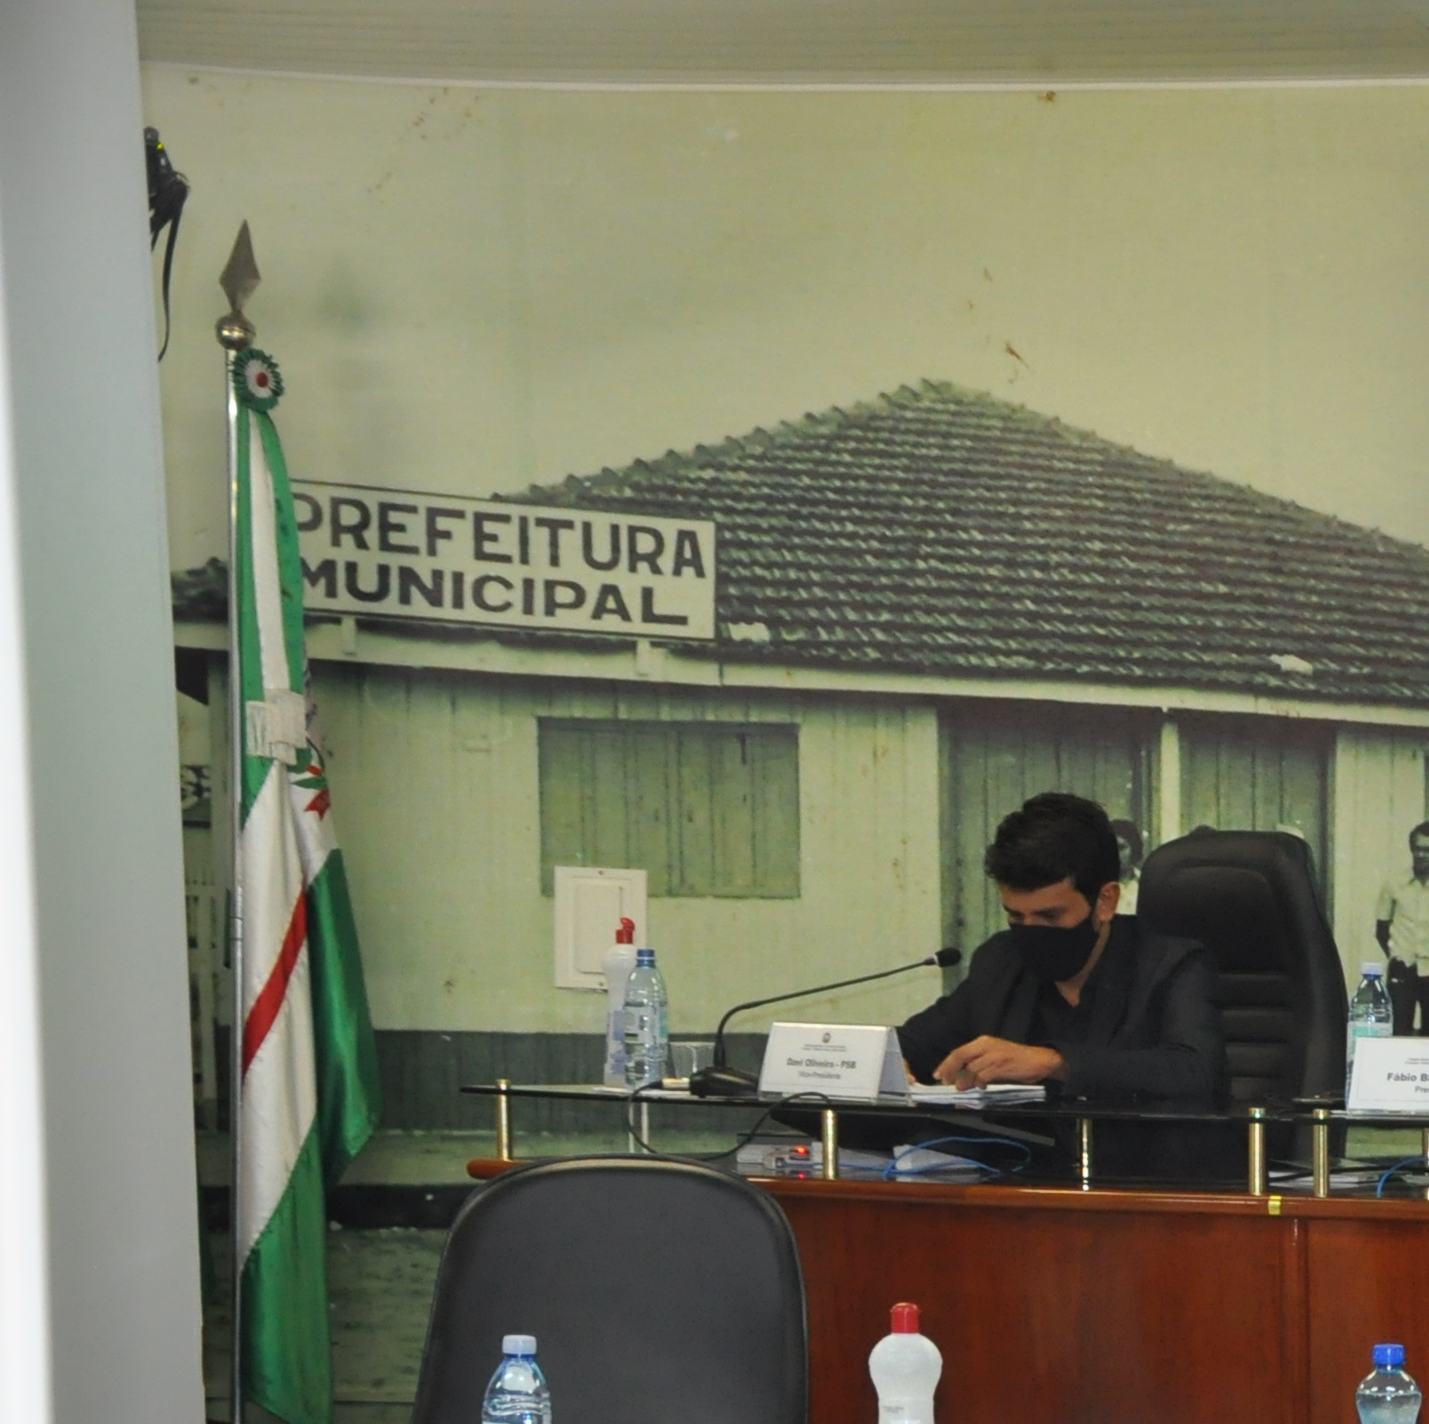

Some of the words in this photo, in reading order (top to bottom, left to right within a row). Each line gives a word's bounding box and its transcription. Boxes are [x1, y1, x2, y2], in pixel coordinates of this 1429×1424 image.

[294, 492, 706, 579] PREFEITURA
[303, 556, 689, 627] MUNICIPAL
[1386, 1072, 1417, 1082] Fábio
